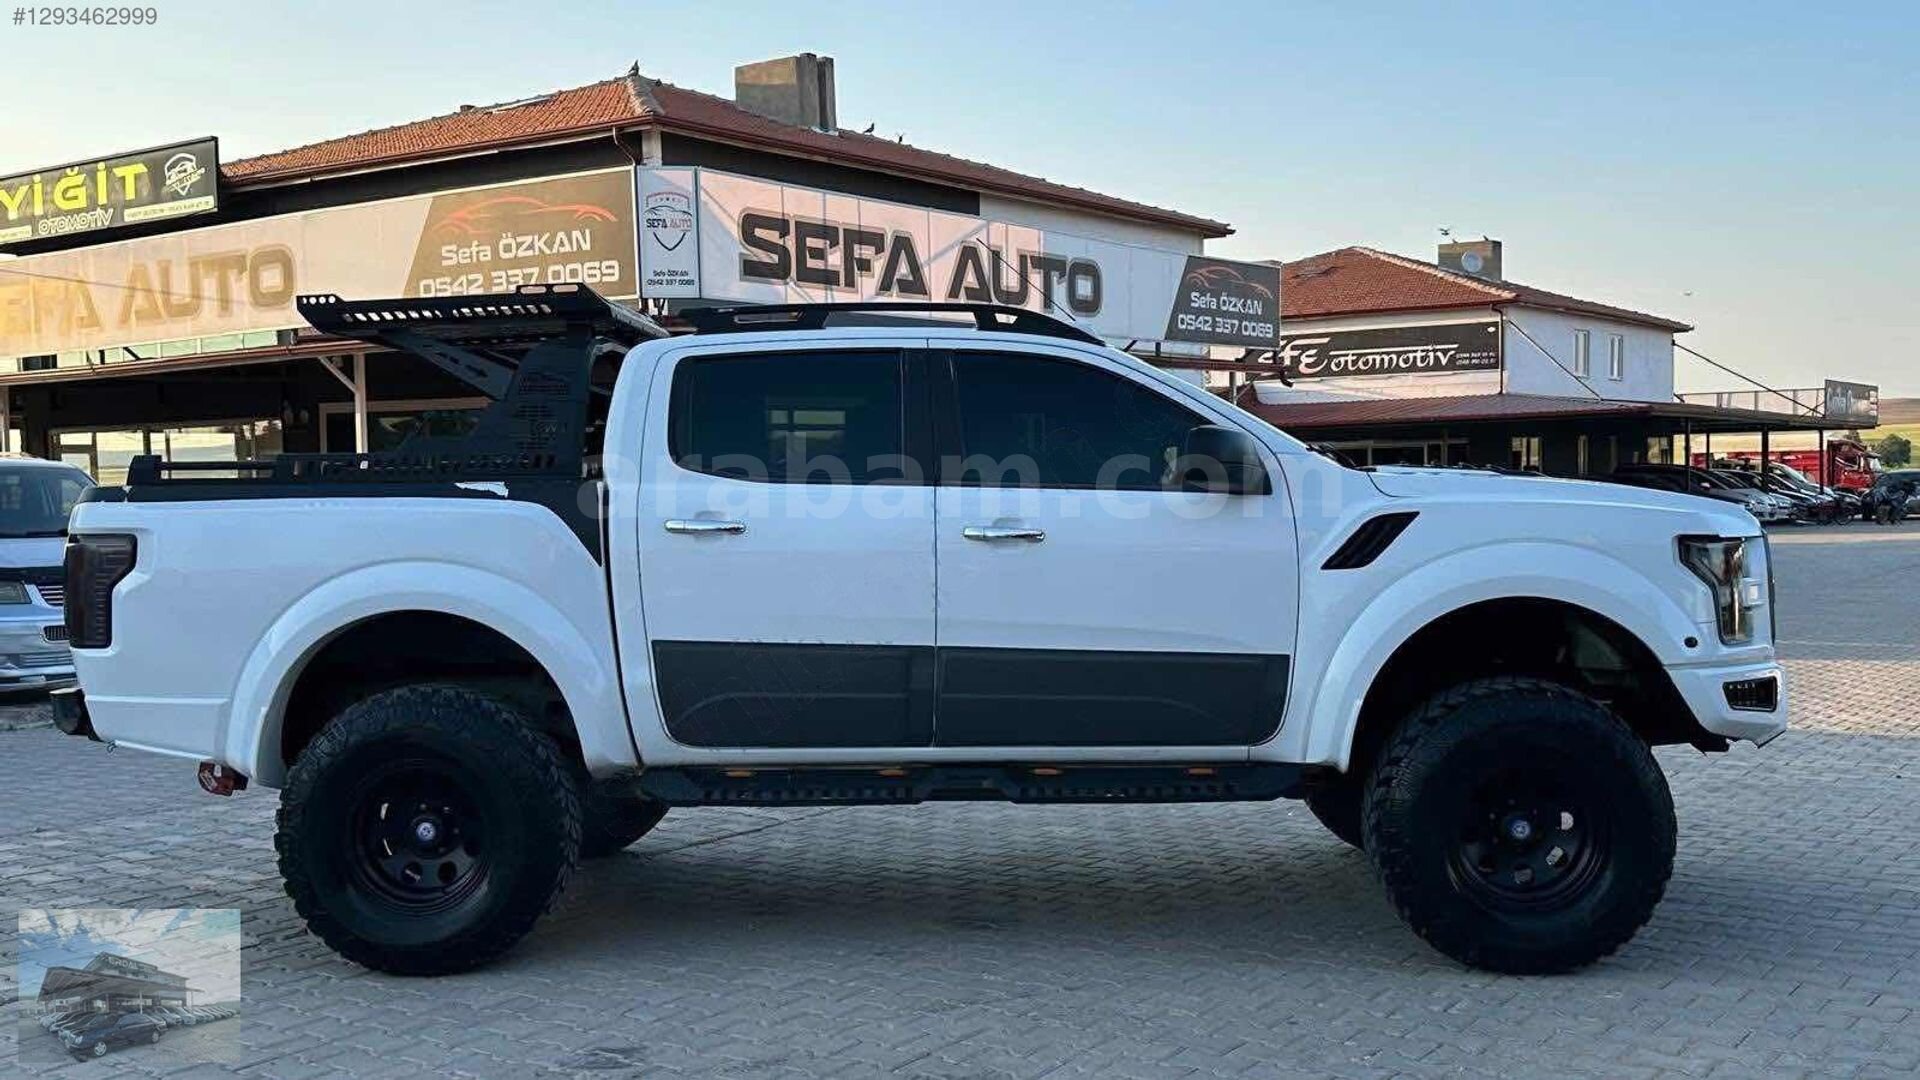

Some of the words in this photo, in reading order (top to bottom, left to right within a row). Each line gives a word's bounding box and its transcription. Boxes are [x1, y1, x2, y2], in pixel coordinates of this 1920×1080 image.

[0, 161, 149, 221] YİĞİT
[38, 207, 114, 235] OTOMOTİV
[646, 218, 668, 229] SEFA
[441, 240, 492, 266] Sefa
[498, 230, 592, 260] ÖZKAN
[738, 208, 932, 301] SEFA
[946, 240, 1104, 317] AUTO
[119, 244, 294, 324] AUTO
[419, 273, 484, 298] 0542
[491, 266, 539, 292] 337
[547, 260, 620, 286] 0069
[1190, 291, 1217, 310] Sefa
[1220, 291, 1263, 316] ÖZKAN
[1177, 313, 1213, 332] 0542
[1215, 317, 1239, 335] 337
[1241, 320, 1274, 339] 0069
